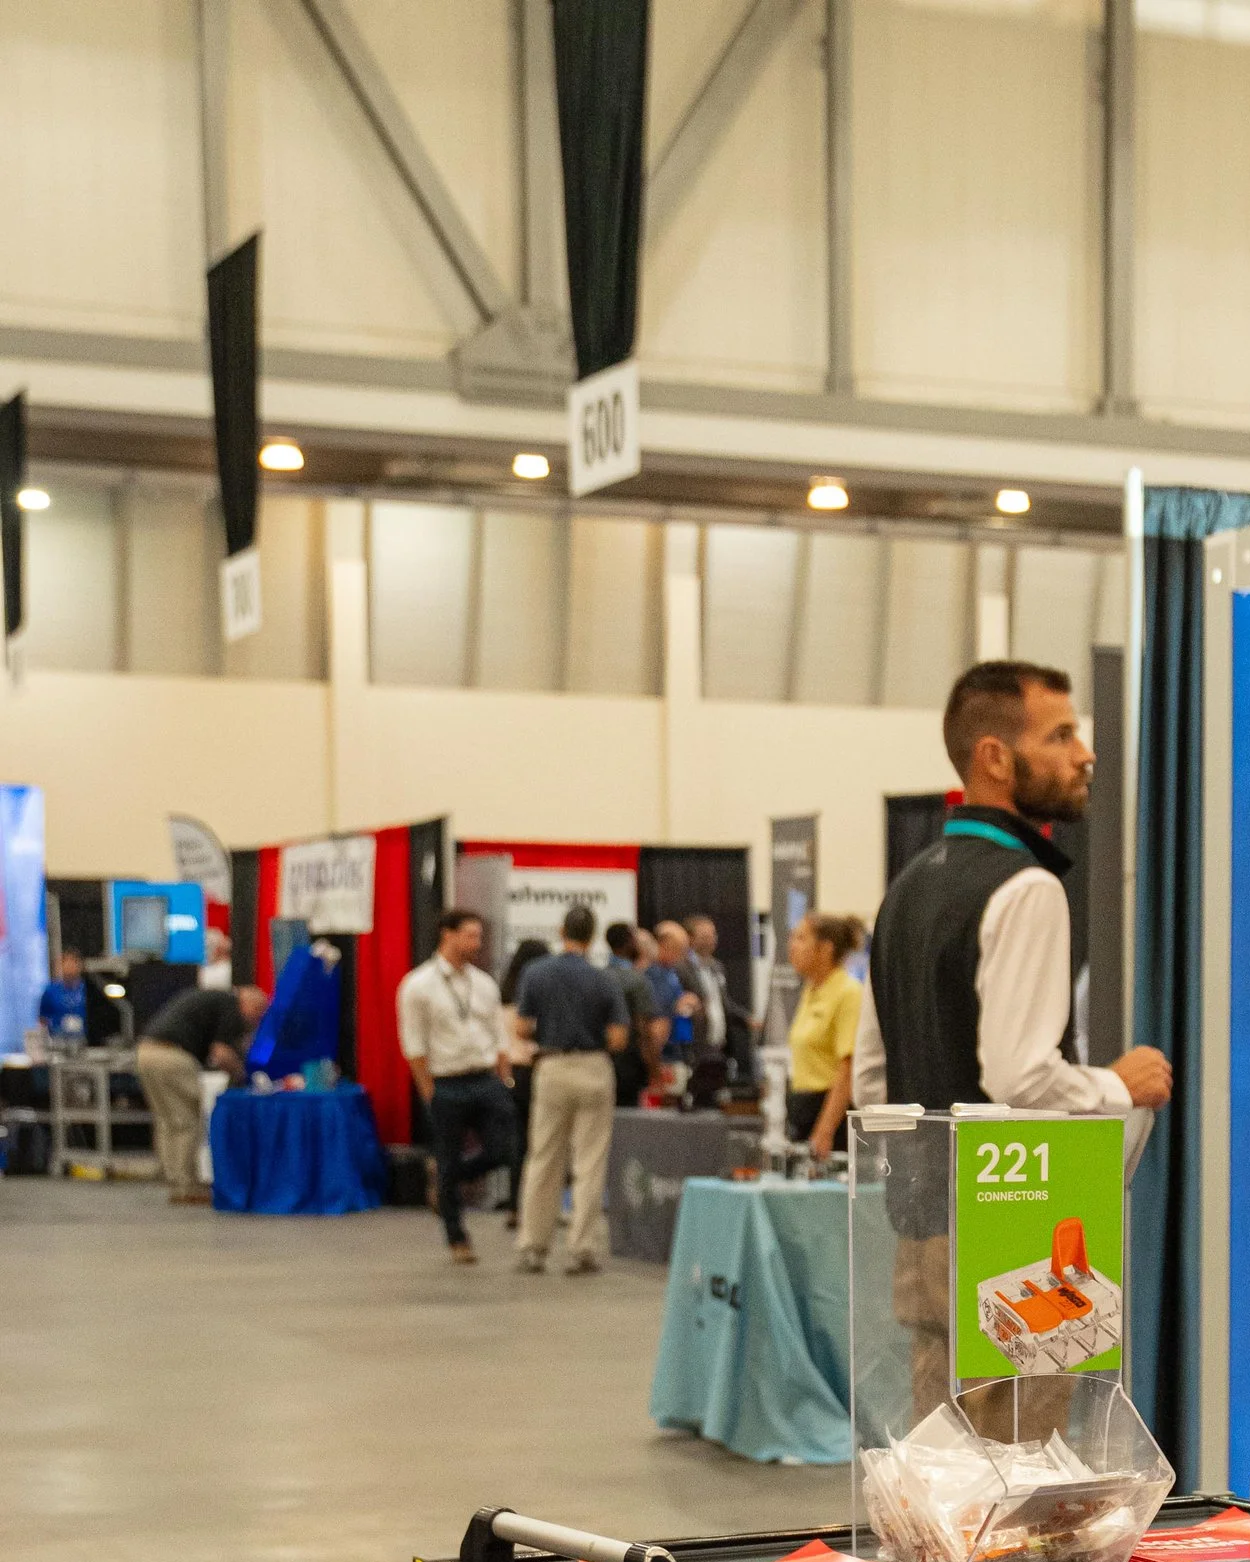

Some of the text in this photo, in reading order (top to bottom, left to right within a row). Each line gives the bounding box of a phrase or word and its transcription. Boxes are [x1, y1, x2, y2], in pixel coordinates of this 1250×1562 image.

[583, 390, 626, 468] 600
[977, 1142, 1049, 1183] 221
[977, 1190, 1049, 1202] CONNECTORS
